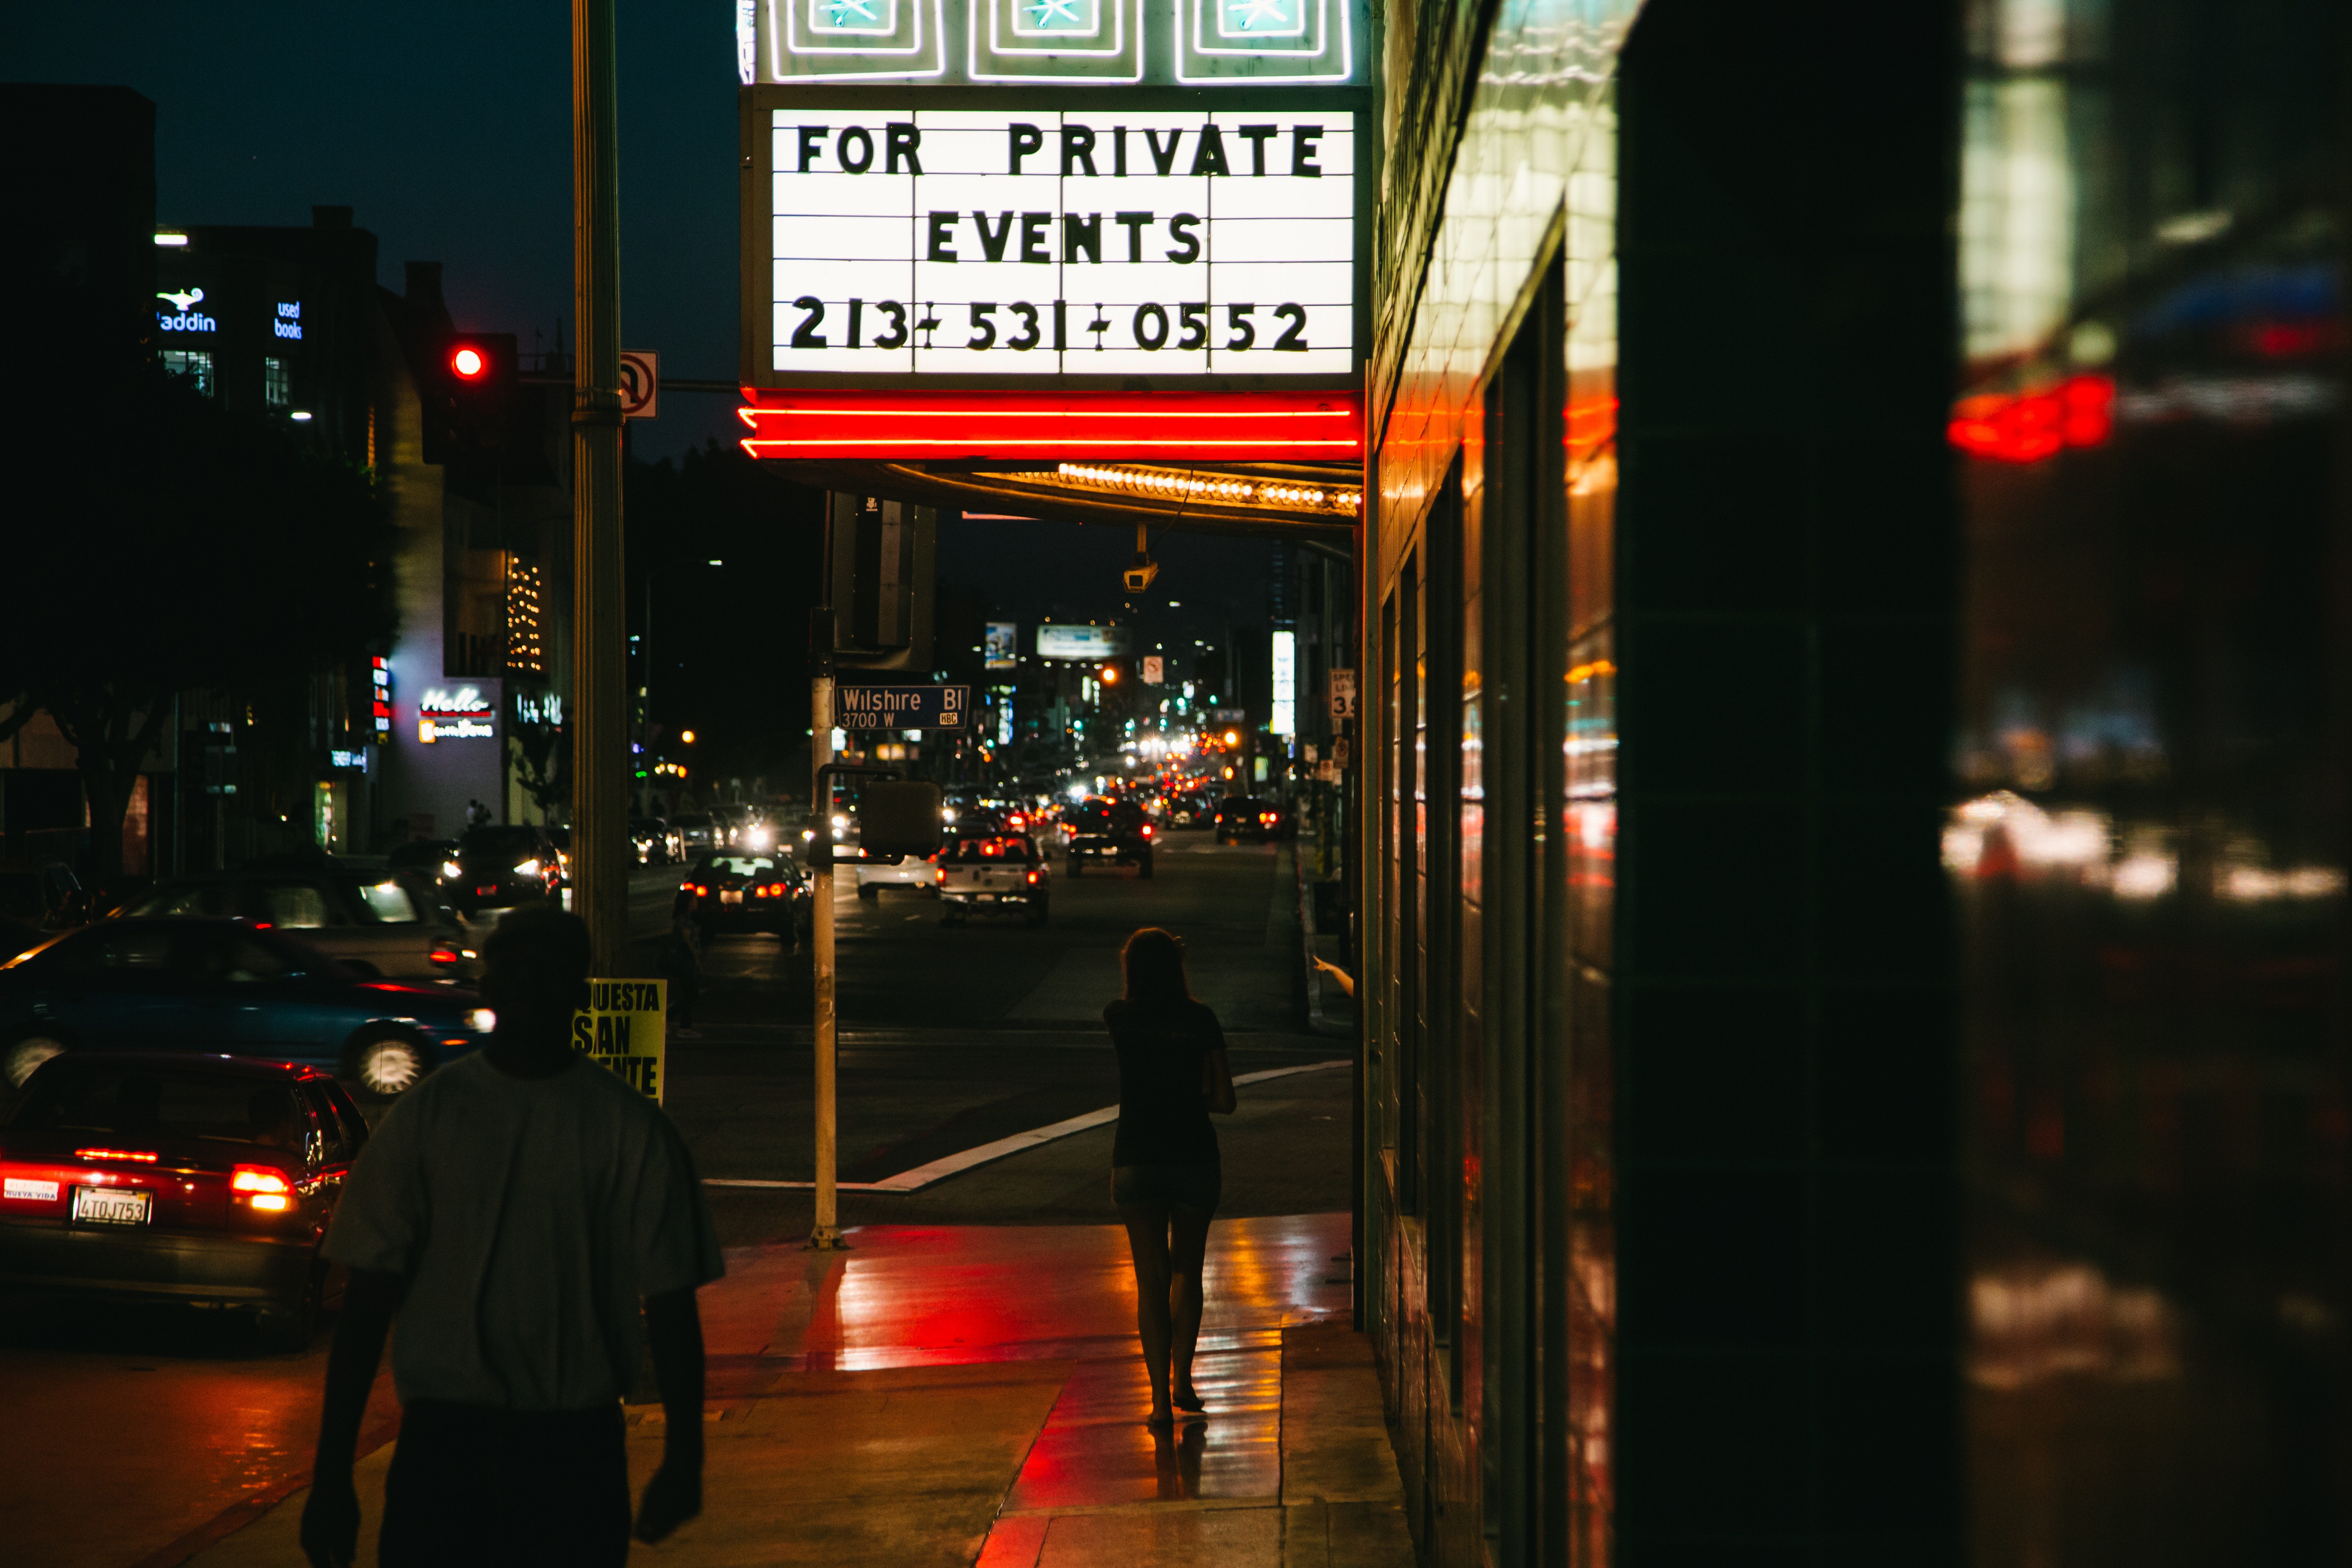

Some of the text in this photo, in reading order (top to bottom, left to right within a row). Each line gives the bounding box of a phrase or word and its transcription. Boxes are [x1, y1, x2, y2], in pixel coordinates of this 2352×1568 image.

[797, 122, 1324, 177] FOR PRIVATE
[927, 210, 1202, 264] EVENTS
[278, 301, 300, 318] used
[157, 312, 216, 332] addin
[274, 318, 302, 339] books
[421, 688, 489, 712] Hello
[844, 688, 961, 711] Wilshire Bl
[842, 712, 895, 728] 3700 W
[574, 1016, 630, 1054] SAN
[6, 1190, 32, 1198] NUEVA
